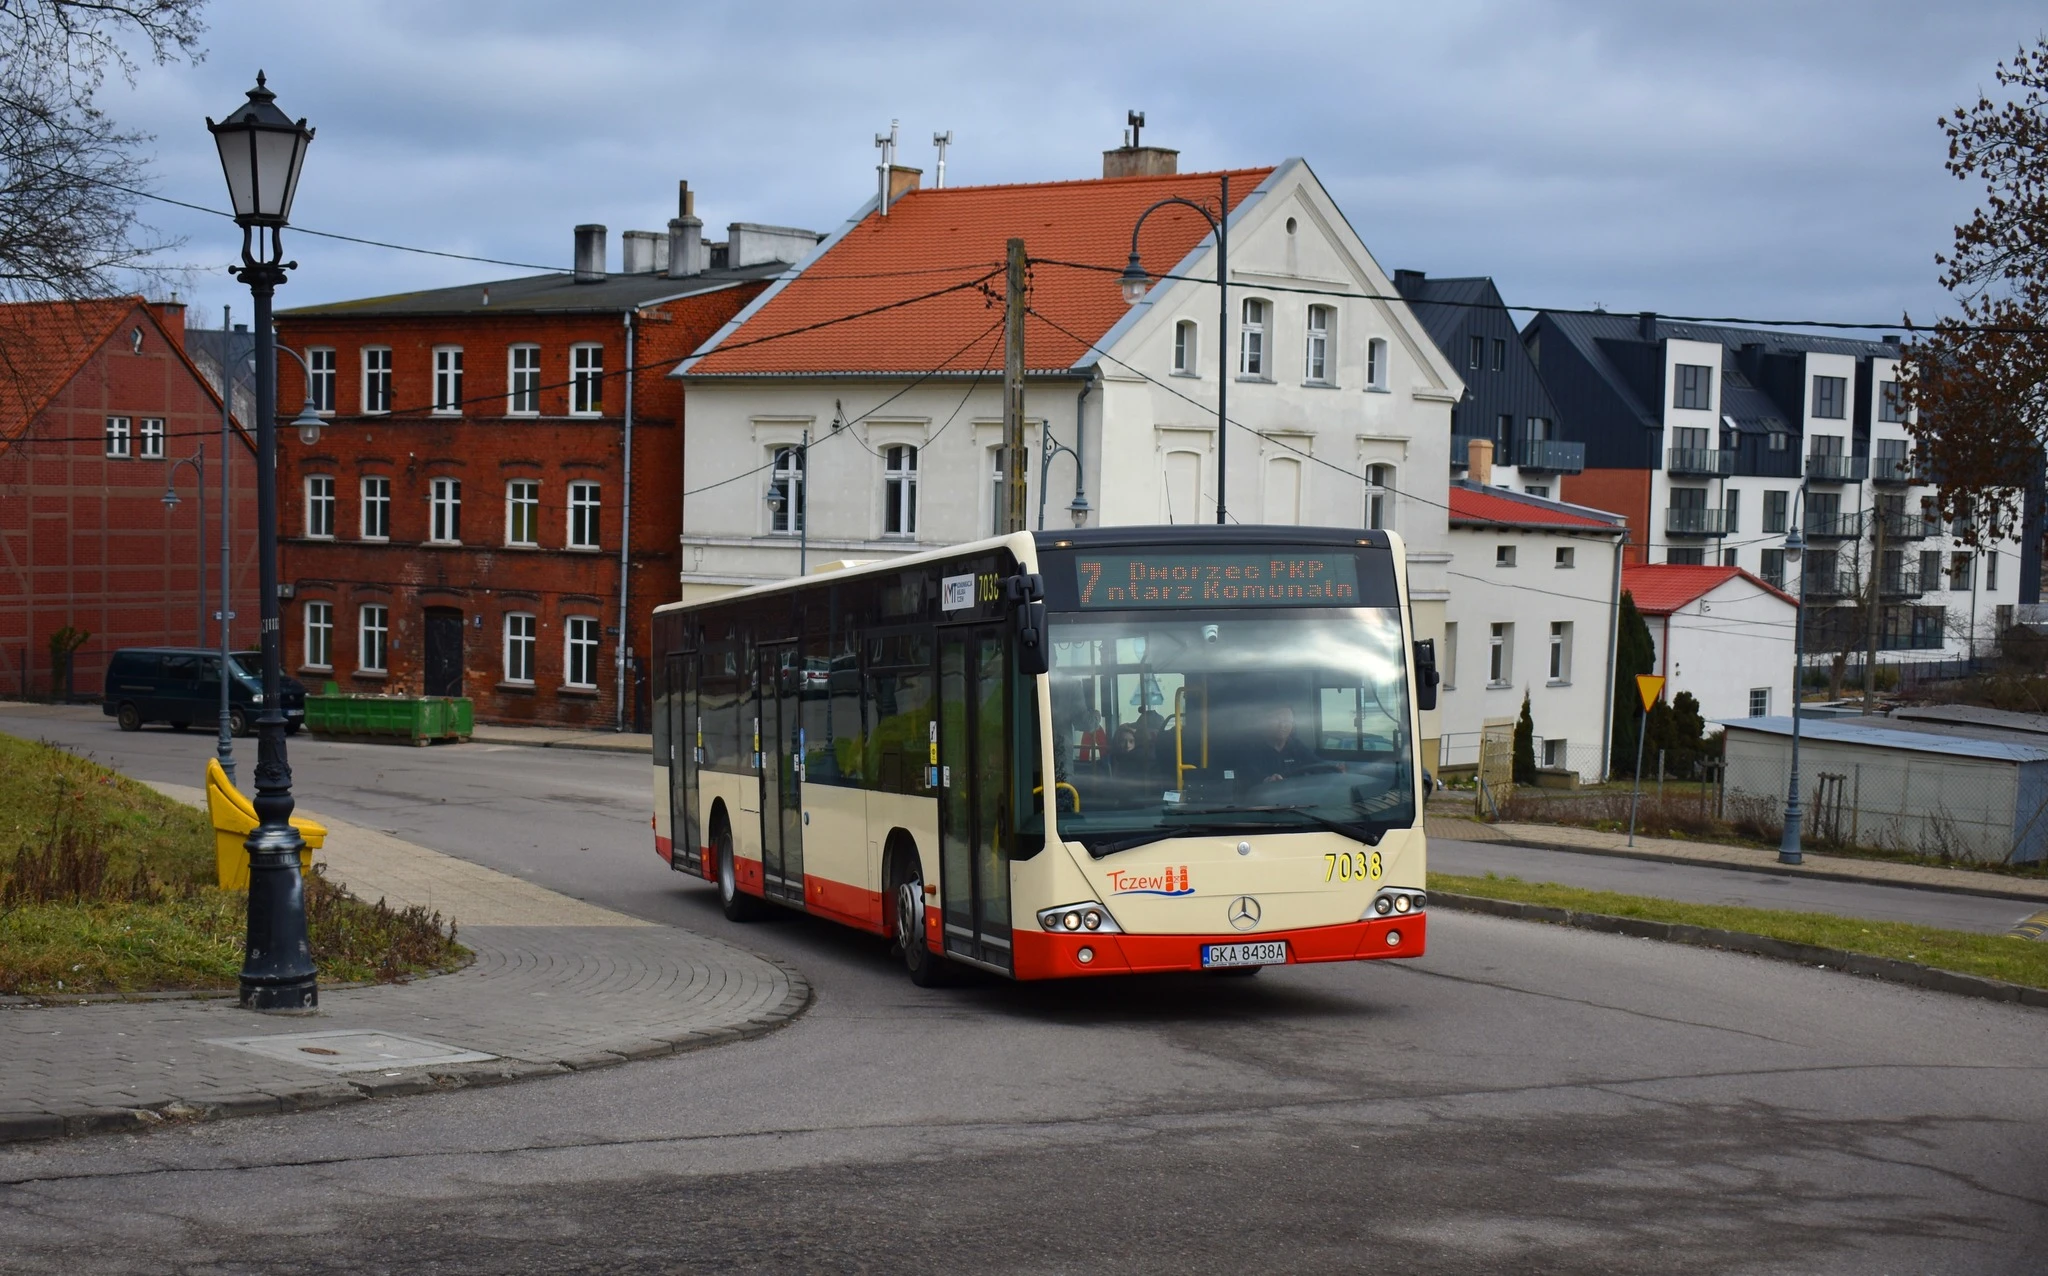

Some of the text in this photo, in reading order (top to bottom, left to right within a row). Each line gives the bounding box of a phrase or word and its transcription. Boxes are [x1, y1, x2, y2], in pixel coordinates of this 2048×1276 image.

[1130, 560, 1324, 580] Dworzec PKP
[1080, 562, 1101, 603] 7
[1108, 580, 1352, 600] ntarz Komunaln
[1324, 851, 1383, 882] 7038
[1106, 870, 1163, 892] Tczew
[1210, 943, 1284, 962] GKA 8438A
